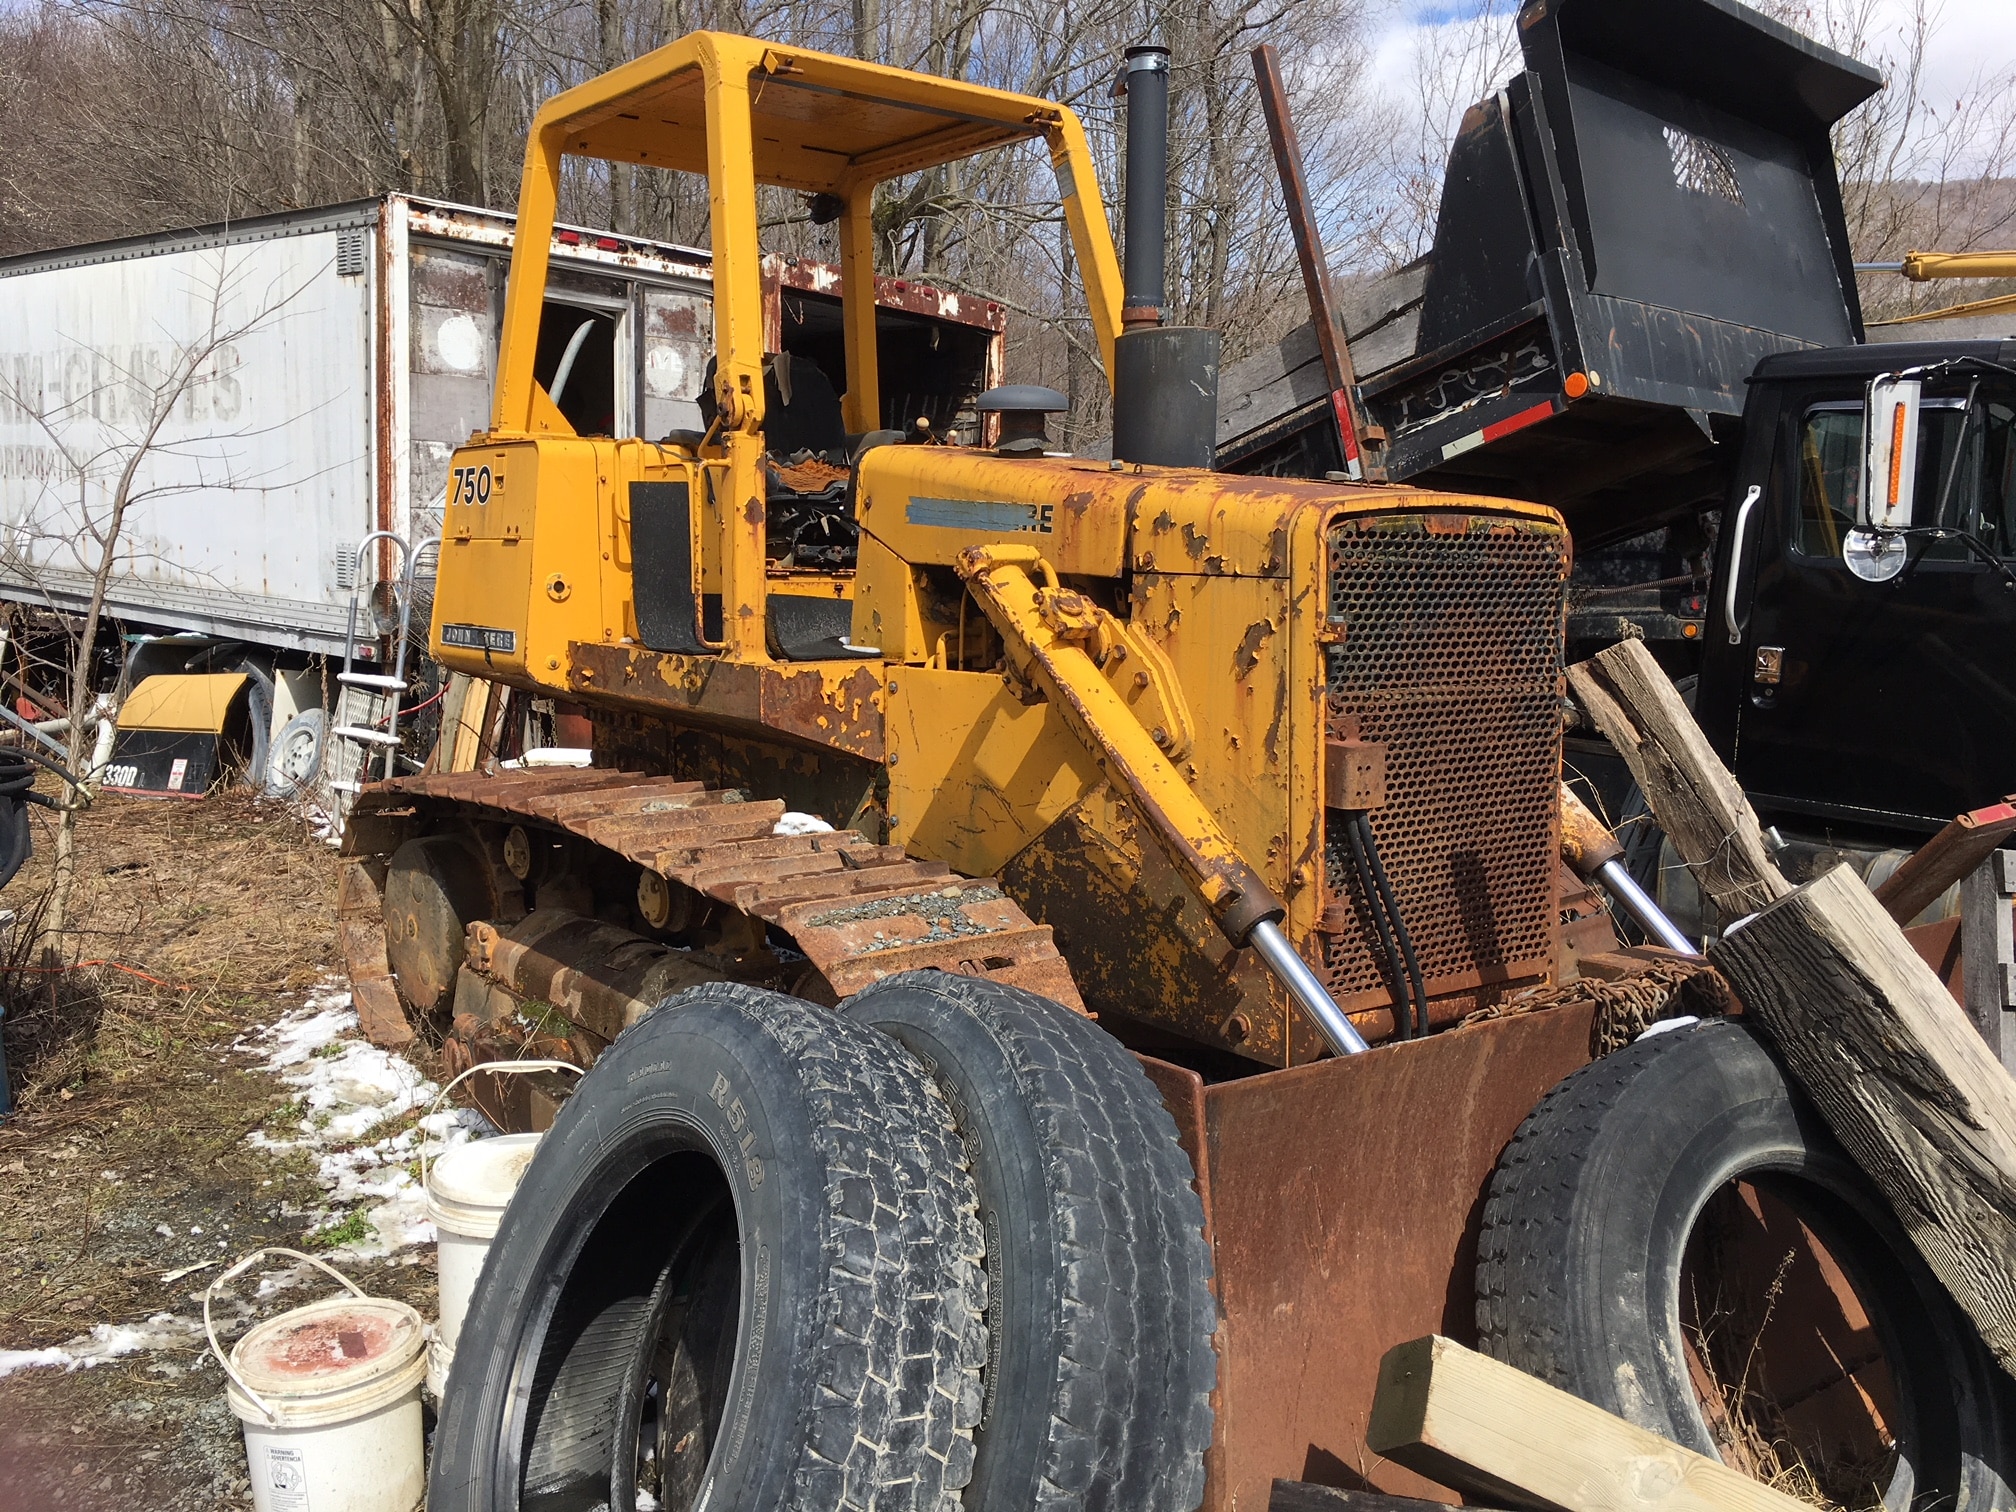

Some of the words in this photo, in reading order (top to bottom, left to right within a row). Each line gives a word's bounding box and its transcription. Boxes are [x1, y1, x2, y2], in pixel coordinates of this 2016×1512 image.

[453, 466, 491, 504] 750
[446, 627, 471, 643] JOHN
[103, 764, 137, 787] 330D
[706, 1070, 765, 1193] R518
